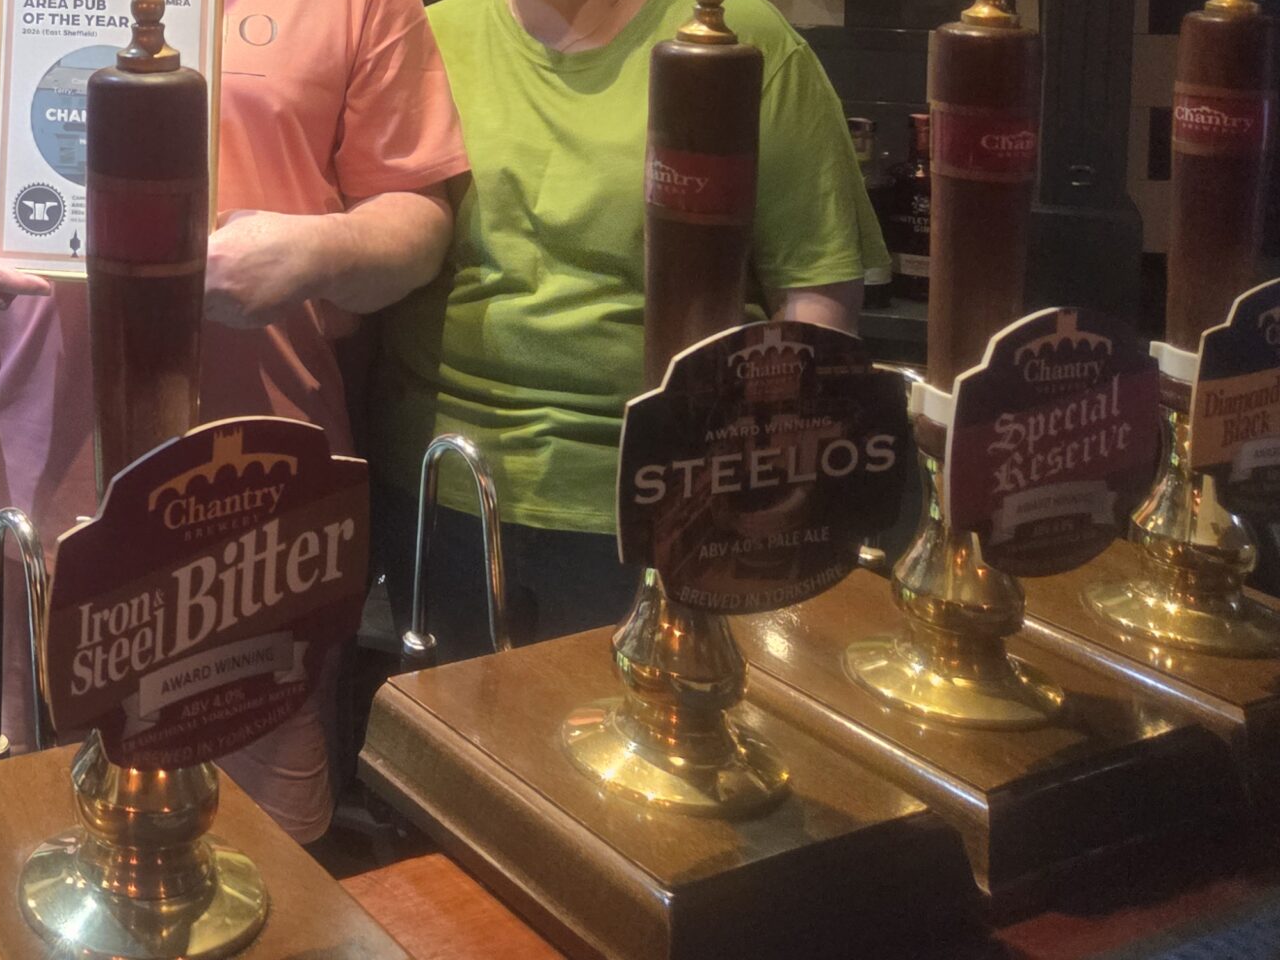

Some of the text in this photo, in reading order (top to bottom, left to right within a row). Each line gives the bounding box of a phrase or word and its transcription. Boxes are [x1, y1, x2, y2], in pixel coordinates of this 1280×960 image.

[23, 12, 130, 28] OF THE YEAR
[63, 29, 98, 37] Sheffield)
[736, 359, 808, 380] Chantry
[1023, 359, 1104, 384] Chantry
[705, 415, 832, 442] AWARD WINNING
[987, 373, 1121, 455] Special
[1221, 410, 1271, 448] Black
[633, 434, 896, 505] STEELOS
[992, 422, 1132, 493] Reserve
[163, 483, 285, 531] Chantry
[184, 512, 261, 542] BREWERY
[698, 543, 729, 560] ABV
[767, 534, 801, 549] PALE
[804, 526, 830, 542] ALE
[170, 517, 355, 657] Bitter
[77, 588, 165, 650] Iron &
[160, 647, 275, 695] AWARD WINNING
[182, 699, 210, 718] ABV
